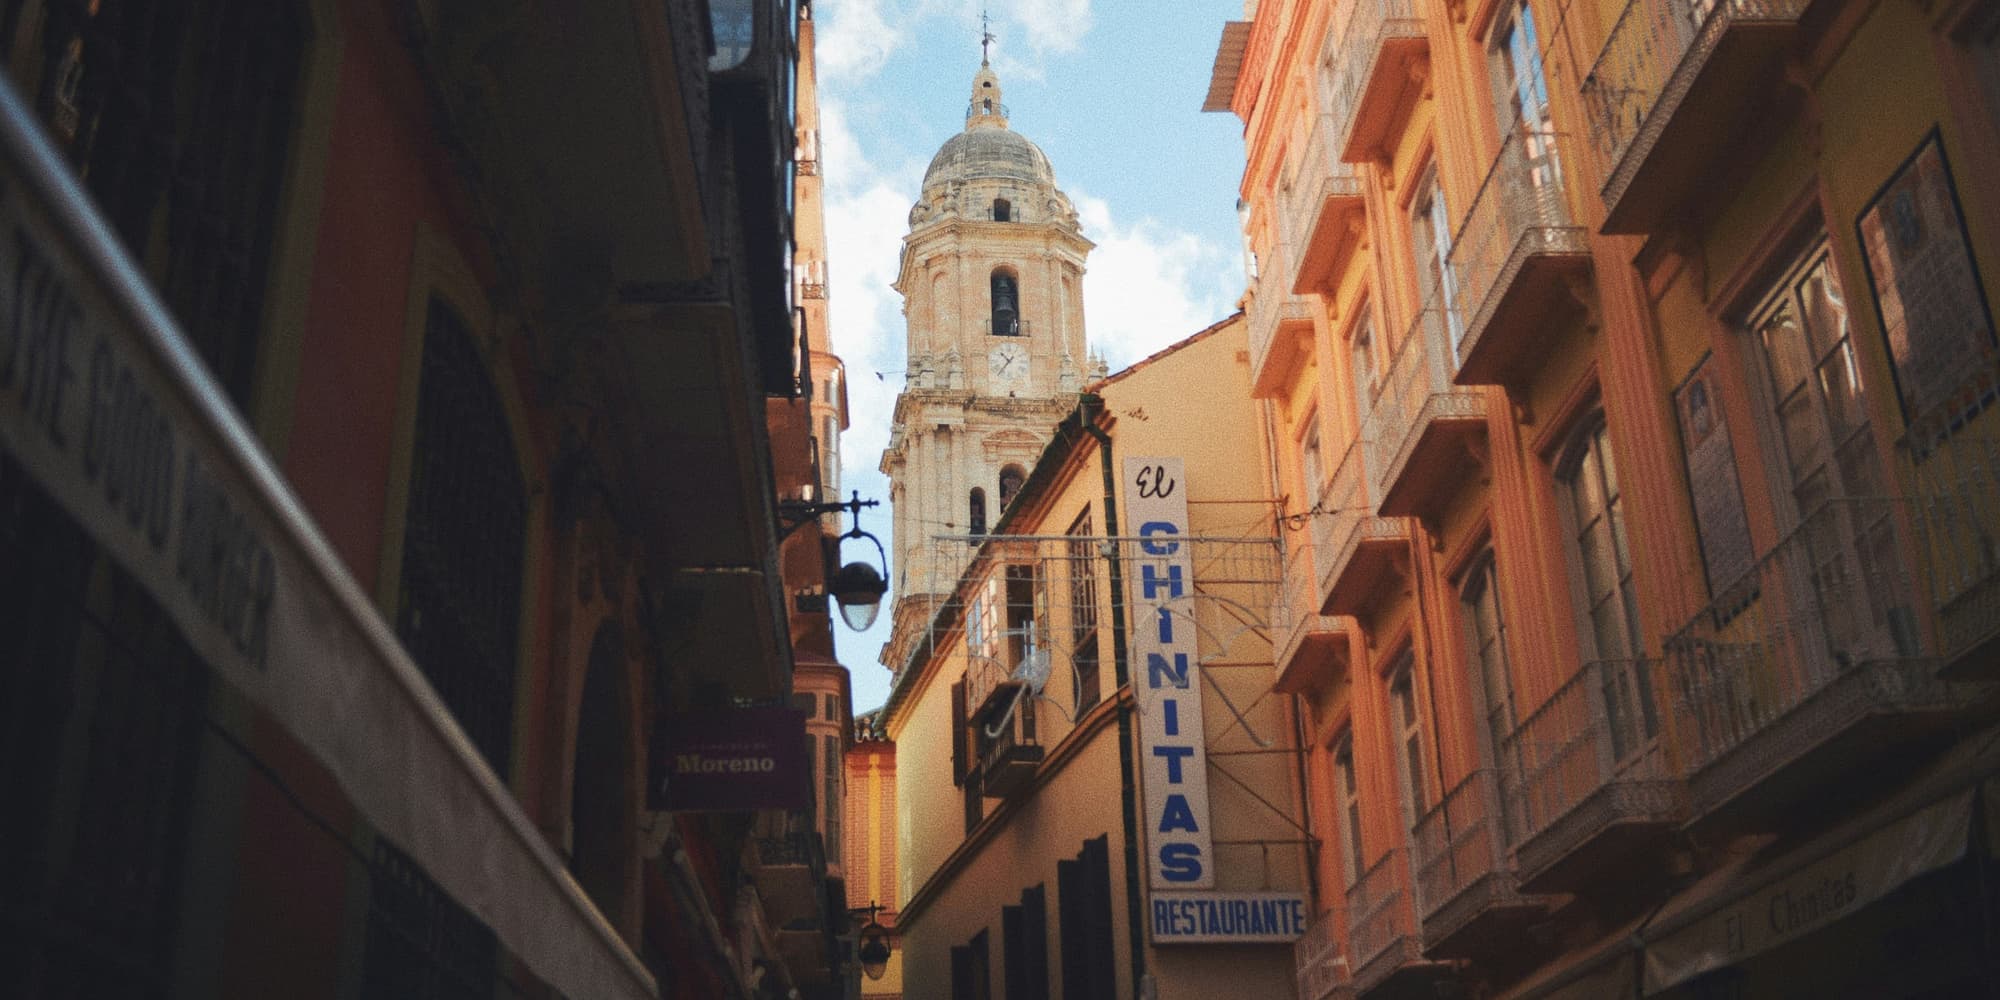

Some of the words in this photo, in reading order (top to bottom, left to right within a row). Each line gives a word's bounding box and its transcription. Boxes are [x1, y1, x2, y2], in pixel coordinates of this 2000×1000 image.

[1, 226, 83, 448] THE
[83, 336, 176, 552] GOOD
[1136, 465, 1175, 498] El
[1139, 521, 1202, 882] CHINITAS
[675, 753, 775, 773] Moreno
[1154, 900, 1305, 936] RESTAURANTE
[1726, 912, 1745, 954] El
[1768, 870, 1858, 934] Chinitas
